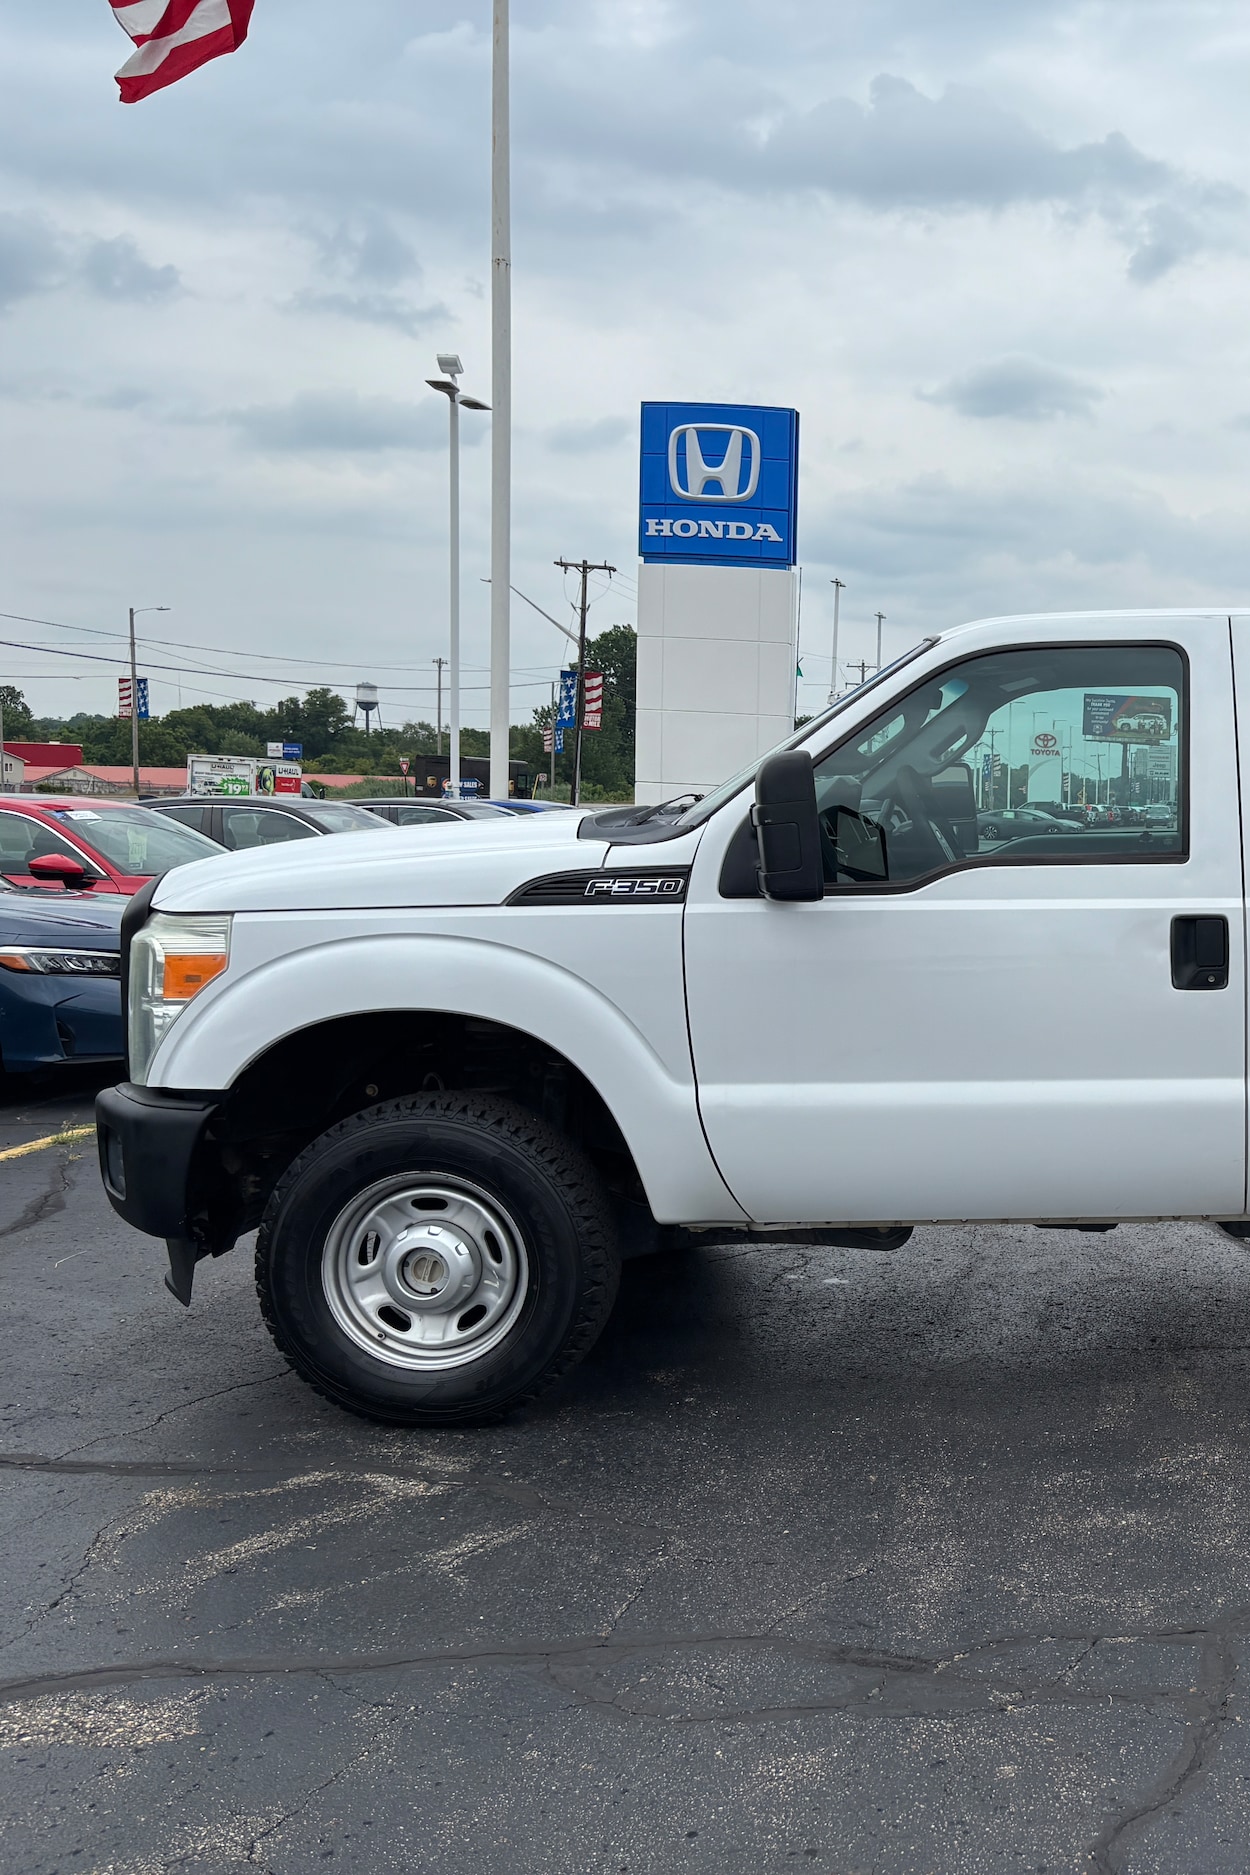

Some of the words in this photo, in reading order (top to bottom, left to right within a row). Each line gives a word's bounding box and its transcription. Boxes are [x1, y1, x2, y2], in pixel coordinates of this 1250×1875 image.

[645, 518, 784, 542] HONDA
[1030, 748, 1061, 756] TOYOTA
[278, 767, 299, 776] U-HAUL
[582, 878, 686, 897] F-350
